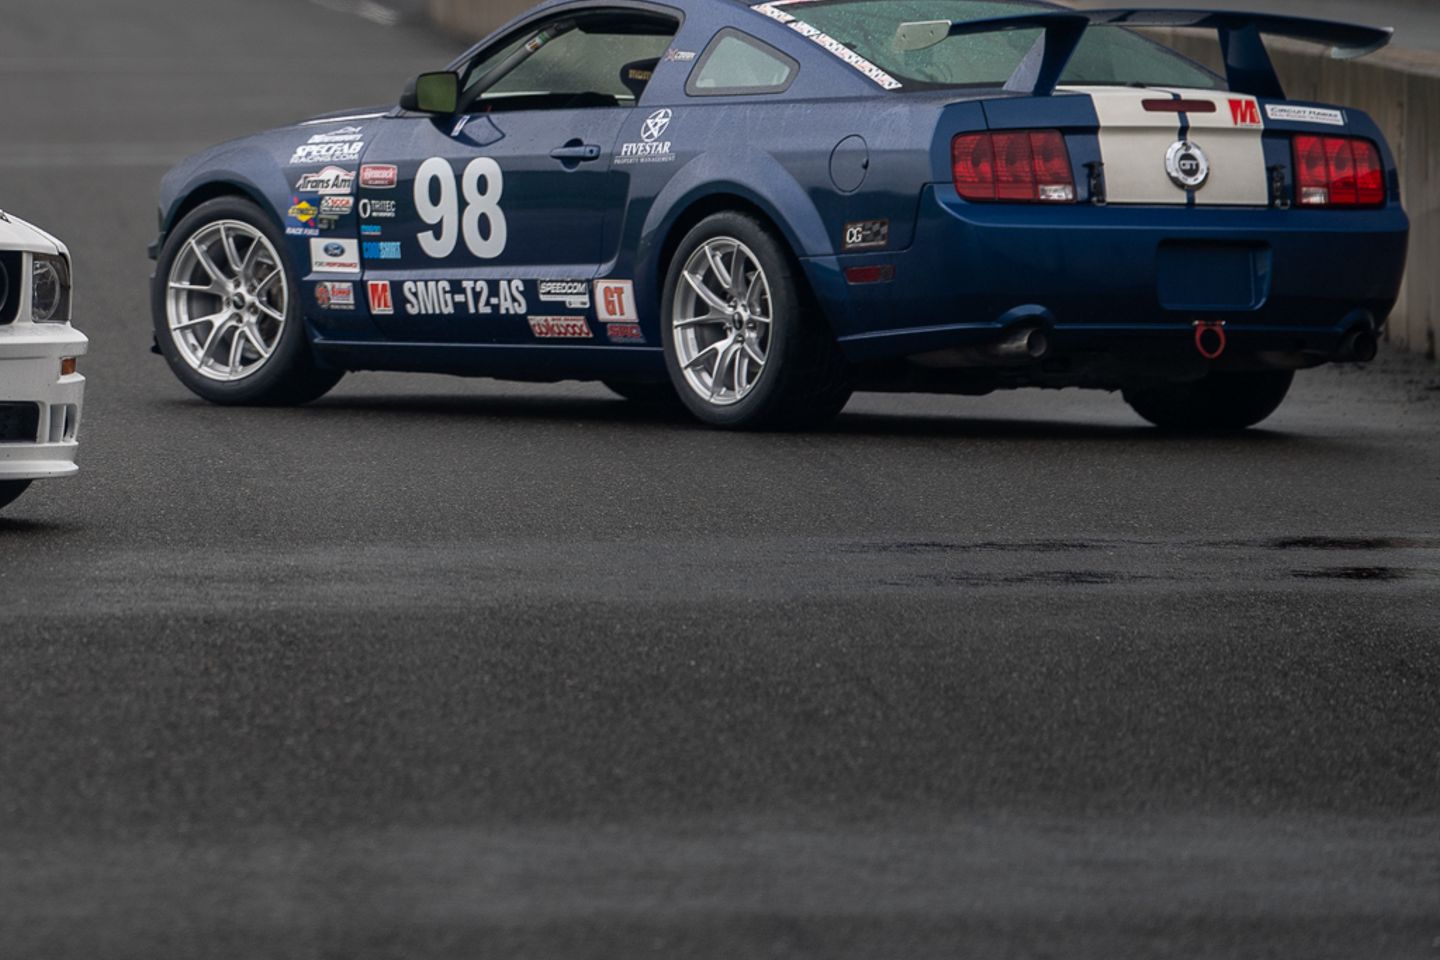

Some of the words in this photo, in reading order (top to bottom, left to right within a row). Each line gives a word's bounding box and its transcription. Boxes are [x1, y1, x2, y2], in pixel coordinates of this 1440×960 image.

[296, 142, 364, 156] SPECFAB
[621, 141, 672, 156] FIVESTAR
[297, 176, 330, 189] Trans
[331, 175, 352, 189] Am
[413, 156, 508, 259] 98
[540, 282, 586, 294] SPEEDCOM
[403, 279, 528, 315] SMG-T2-AS
[603, 286, 626, 317] GT
